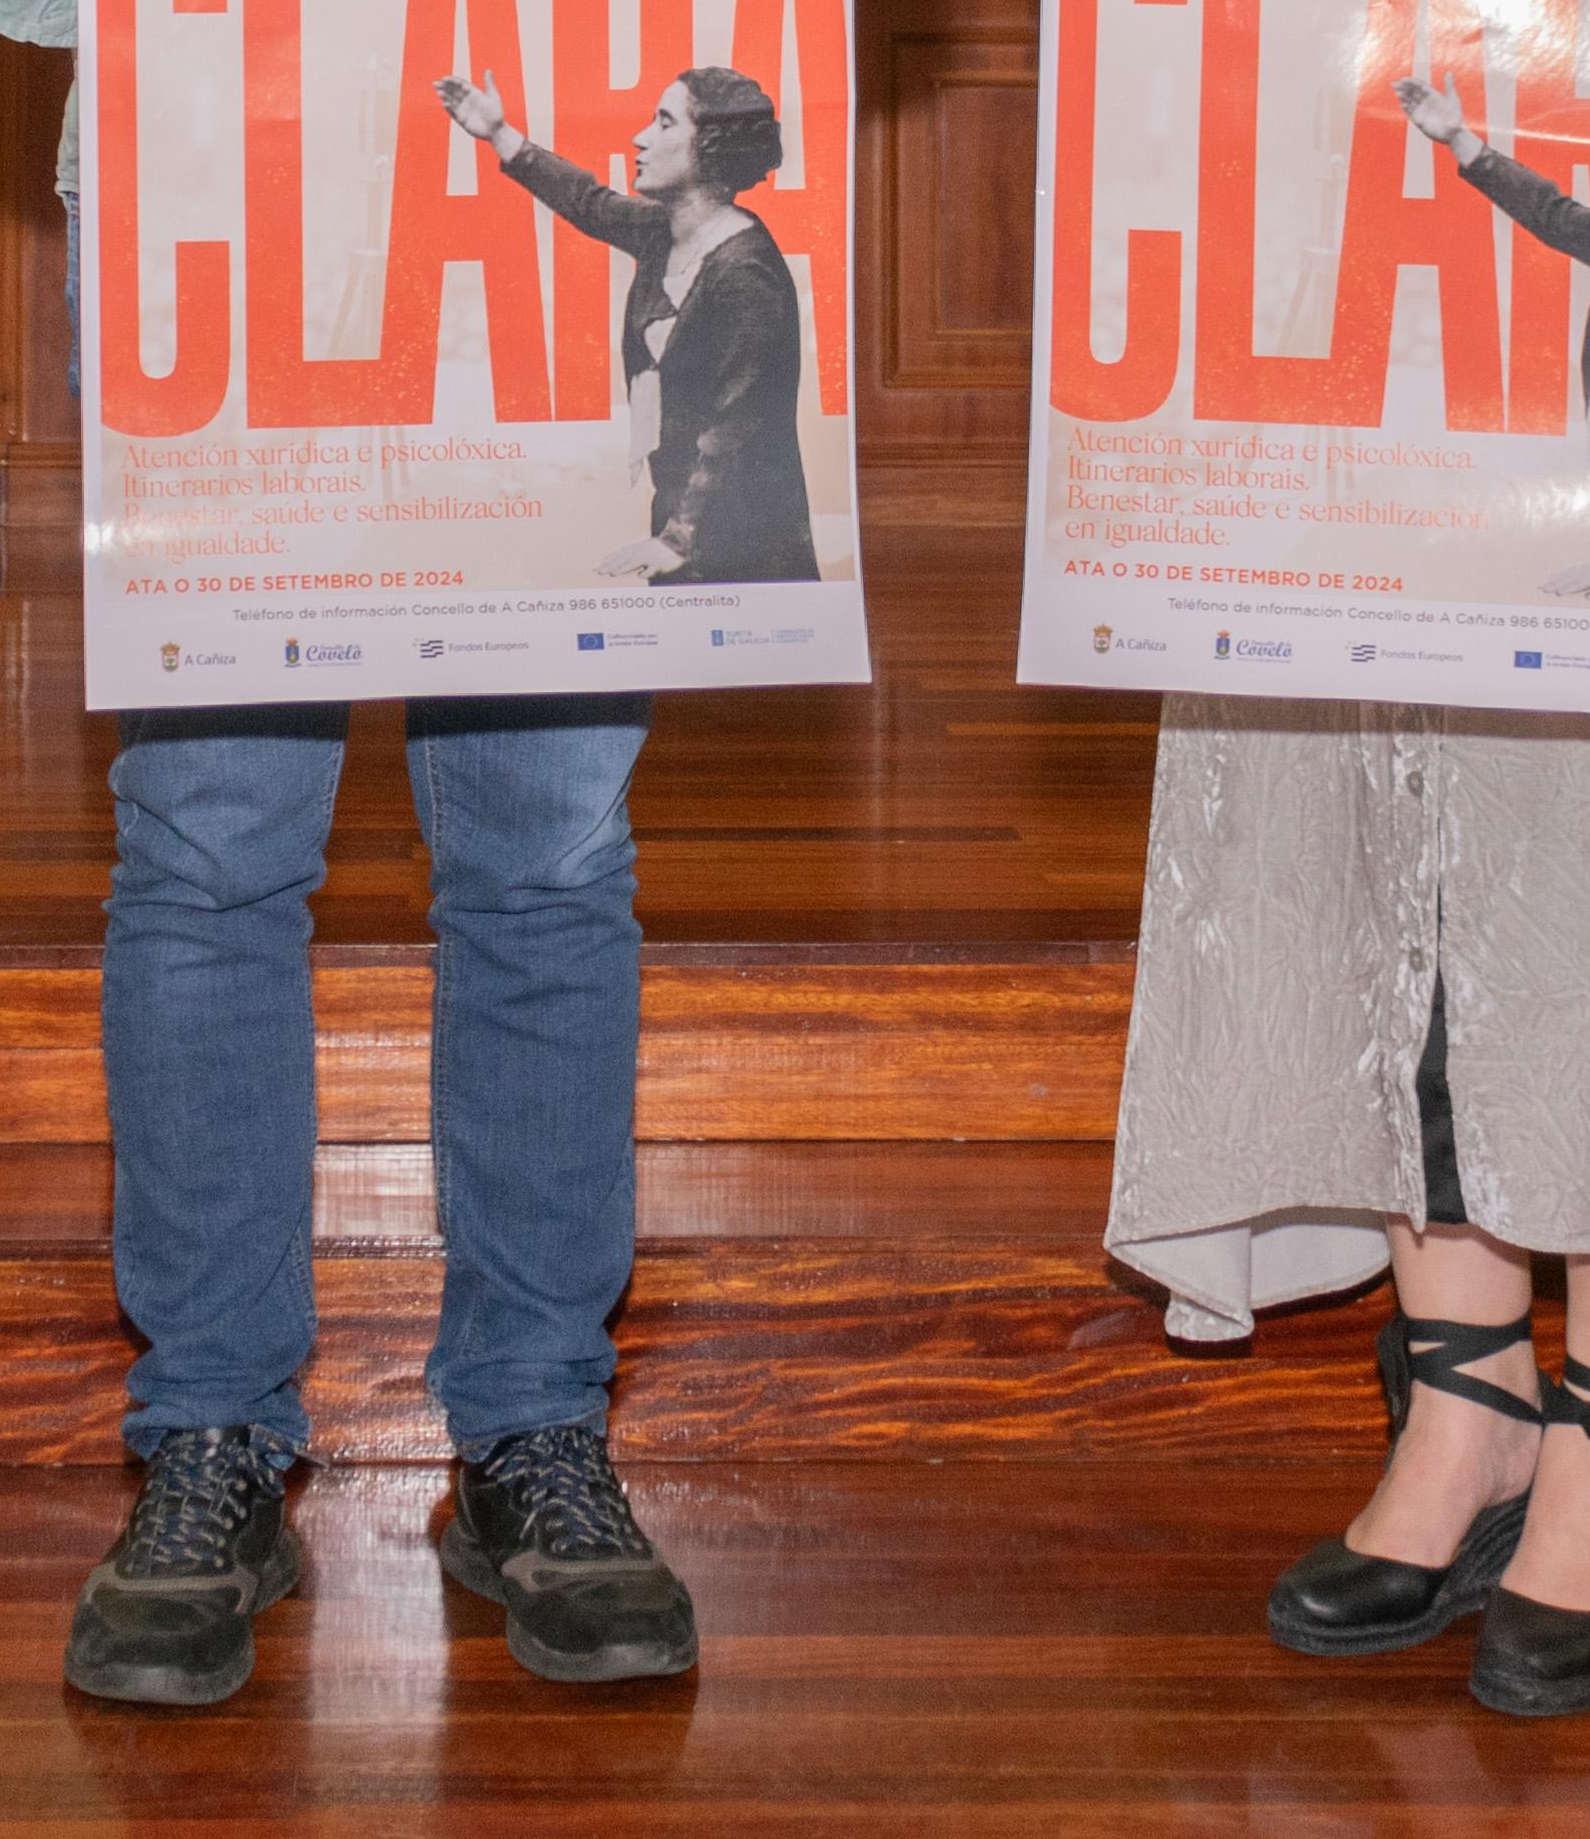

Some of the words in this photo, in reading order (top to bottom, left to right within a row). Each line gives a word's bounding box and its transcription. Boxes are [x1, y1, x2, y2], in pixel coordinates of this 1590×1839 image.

[121, 443, 239, 469] Atención
[246, 439, 350, 466] xurídica
[357, 445, 373, 463] e
[381, 436, 527, 469] psicolóxica.
[1066, 427, 1183, 456] Atención
[1191, 434, 1296, 460] xurídica
[1302, 443, 1318, 462] e
[1326, 441, 1477, 470] psicolóxica.
[123, 473, 254, 499] Itinerarios
[261, 470, 366, 496] laborais.
[1066, 454, 1197, 486] Itinerarios
[1205, 462, 1310, 491] laborais.
[251, 499, 325, 525] saúde
[333, 505, 349, 523] e
[356, 494, 544, 523] sensibilización
[1192, 494, 1266, 519] saúde
[1274, 501, 1291, 521] e
[164, 529, 291, 564] igualdade.
[1065, 520, 1096, 539] en
[1104, 518, 1231, 549] igualdade.
[124, 578, 168, 595] ATA
[173, 577, 191, 594] O
[197, 577, 222, 593] 30
[229, 576, 256, 592] DE
[263, 572, 374, 591] SETEMBRO
[380, 571, 407, 588] DE
[413, 570, 464, 587] 2024
[1064, 559, 1106, 577] ATA
[1112, 562, 1128, 577] O
[1134, 563, 1159, 579] 30
[1166, 565, 1194, 581] DE
[1199, 567, 1311, 587] SETEMBRO
[1318, 572, 1346, 589] DE
[1352, 574, 1404, 592] 2024
[232, 608, 294, 622] Teléfono
[299, 607, 317, 620] de
[321, 604, 407, 619] información
[412, 603, 475, 616] Concello
[478, 601, 497, 614] de
[501, 601, 513, 613] A
[516, 600, 565, 613] Cañiza
[569, 598, 597, 611] 986
[601, 596, 656, 610] 651000
[659, 595, 741, 610] (Centralita)
[1167, 597, 1229, 612] Teléfono
[1233, 601, 1252, 614] de
[1256, 602, 1343, 618] información
[1347, 607, 1412, 623] Concello
[1416, 610, 1435, 623] de
[1439, 612, 1451, 624] A
[1455, 613, 1506, 627] Cañiza
[1509, 615, 1539, 628] 986
[306, 644, 362, 662] Covelo
[448, 642, 483, 653] Fondos
[485, 640, 529, 653] Europeos
[1115, 638, 1126, 650] A
[1127, 638, 1167, 652] Cañiza
[1236, 639, 1292, 658] Covelo
[1380, 649, 1416, 660] Fondos
[1418, 650, 1464, 663] Europeos
[184, 655, 194, 667] A
[196, 652, 237, 666] Cañiza
